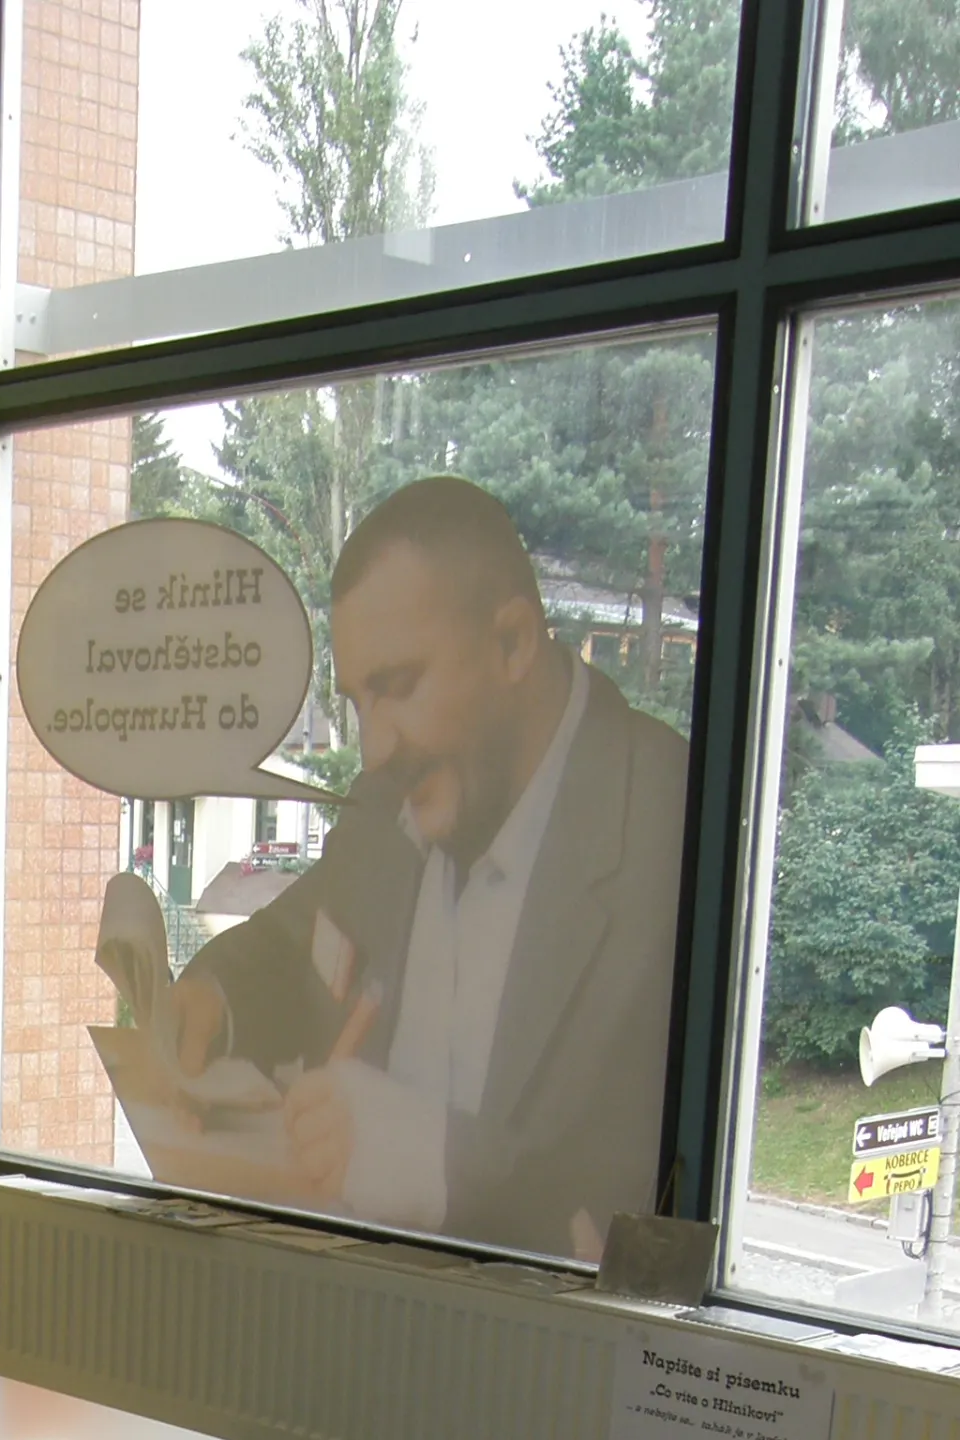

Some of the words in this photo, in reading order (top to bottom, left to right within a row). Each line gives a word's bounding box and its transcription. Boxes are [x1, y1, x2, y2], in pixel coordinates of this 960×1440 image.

[909, 1118, 924, 1137] WC
[885, 1149, 929, 1170] KOBERCE
[893, 1179, 915, 1193] PEPO
[643, 1350, 702, 1377] Napište
[706, 1367, 720, 1383] si
[725, 1372, 800, 1399] písemku
[701, 1397, 709, 1408] o
[746, 1431, 754, 1440] v
